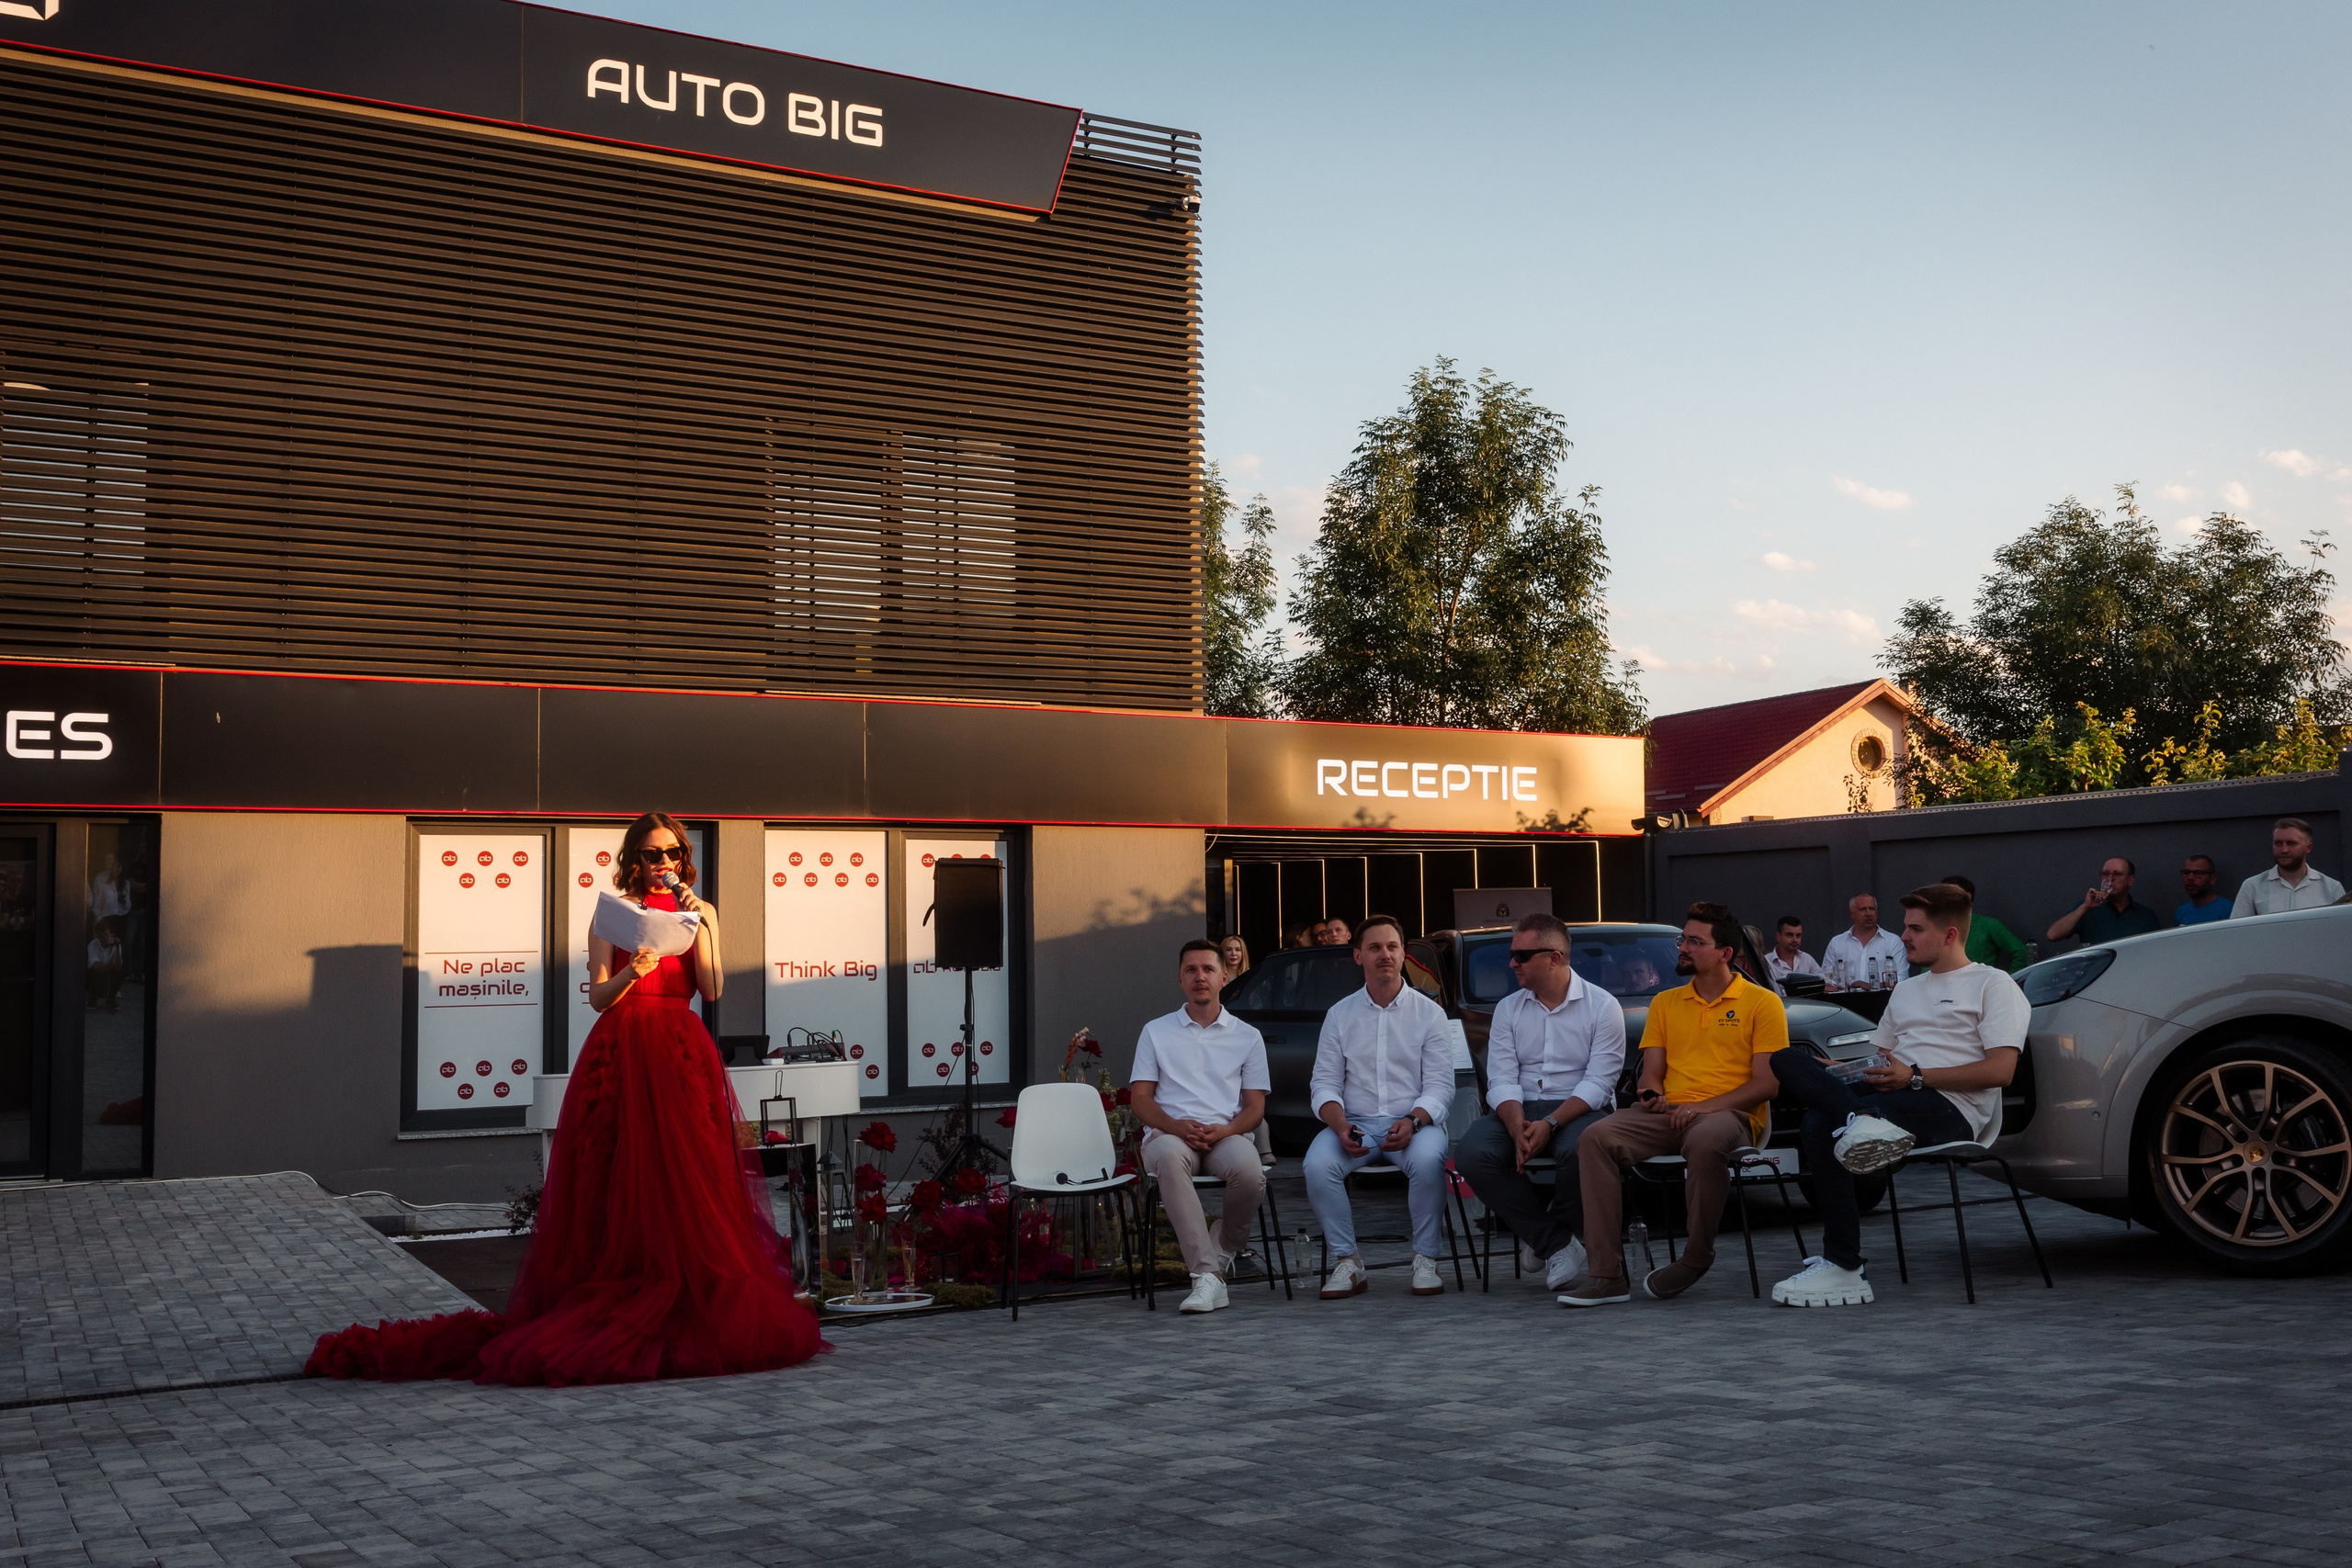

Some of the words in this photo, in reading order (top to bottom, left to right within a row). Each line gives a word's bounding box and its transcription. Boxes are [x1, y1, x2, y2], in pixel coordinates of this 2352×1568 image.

[587, 58, 765, 126] AUTO
[787, 92, 883, 147] BIG
[6, 710, 113, 761] ES
[1317, 758, 1537, 801] RECEPTIE
[444, 960, 473, 974] Ne
[481, 958, 525, 976] plac
[775, 961, 836, 978] Think
[844, 960, 877, 981] Big
[439, 979, 528, 1000] mașinile,
